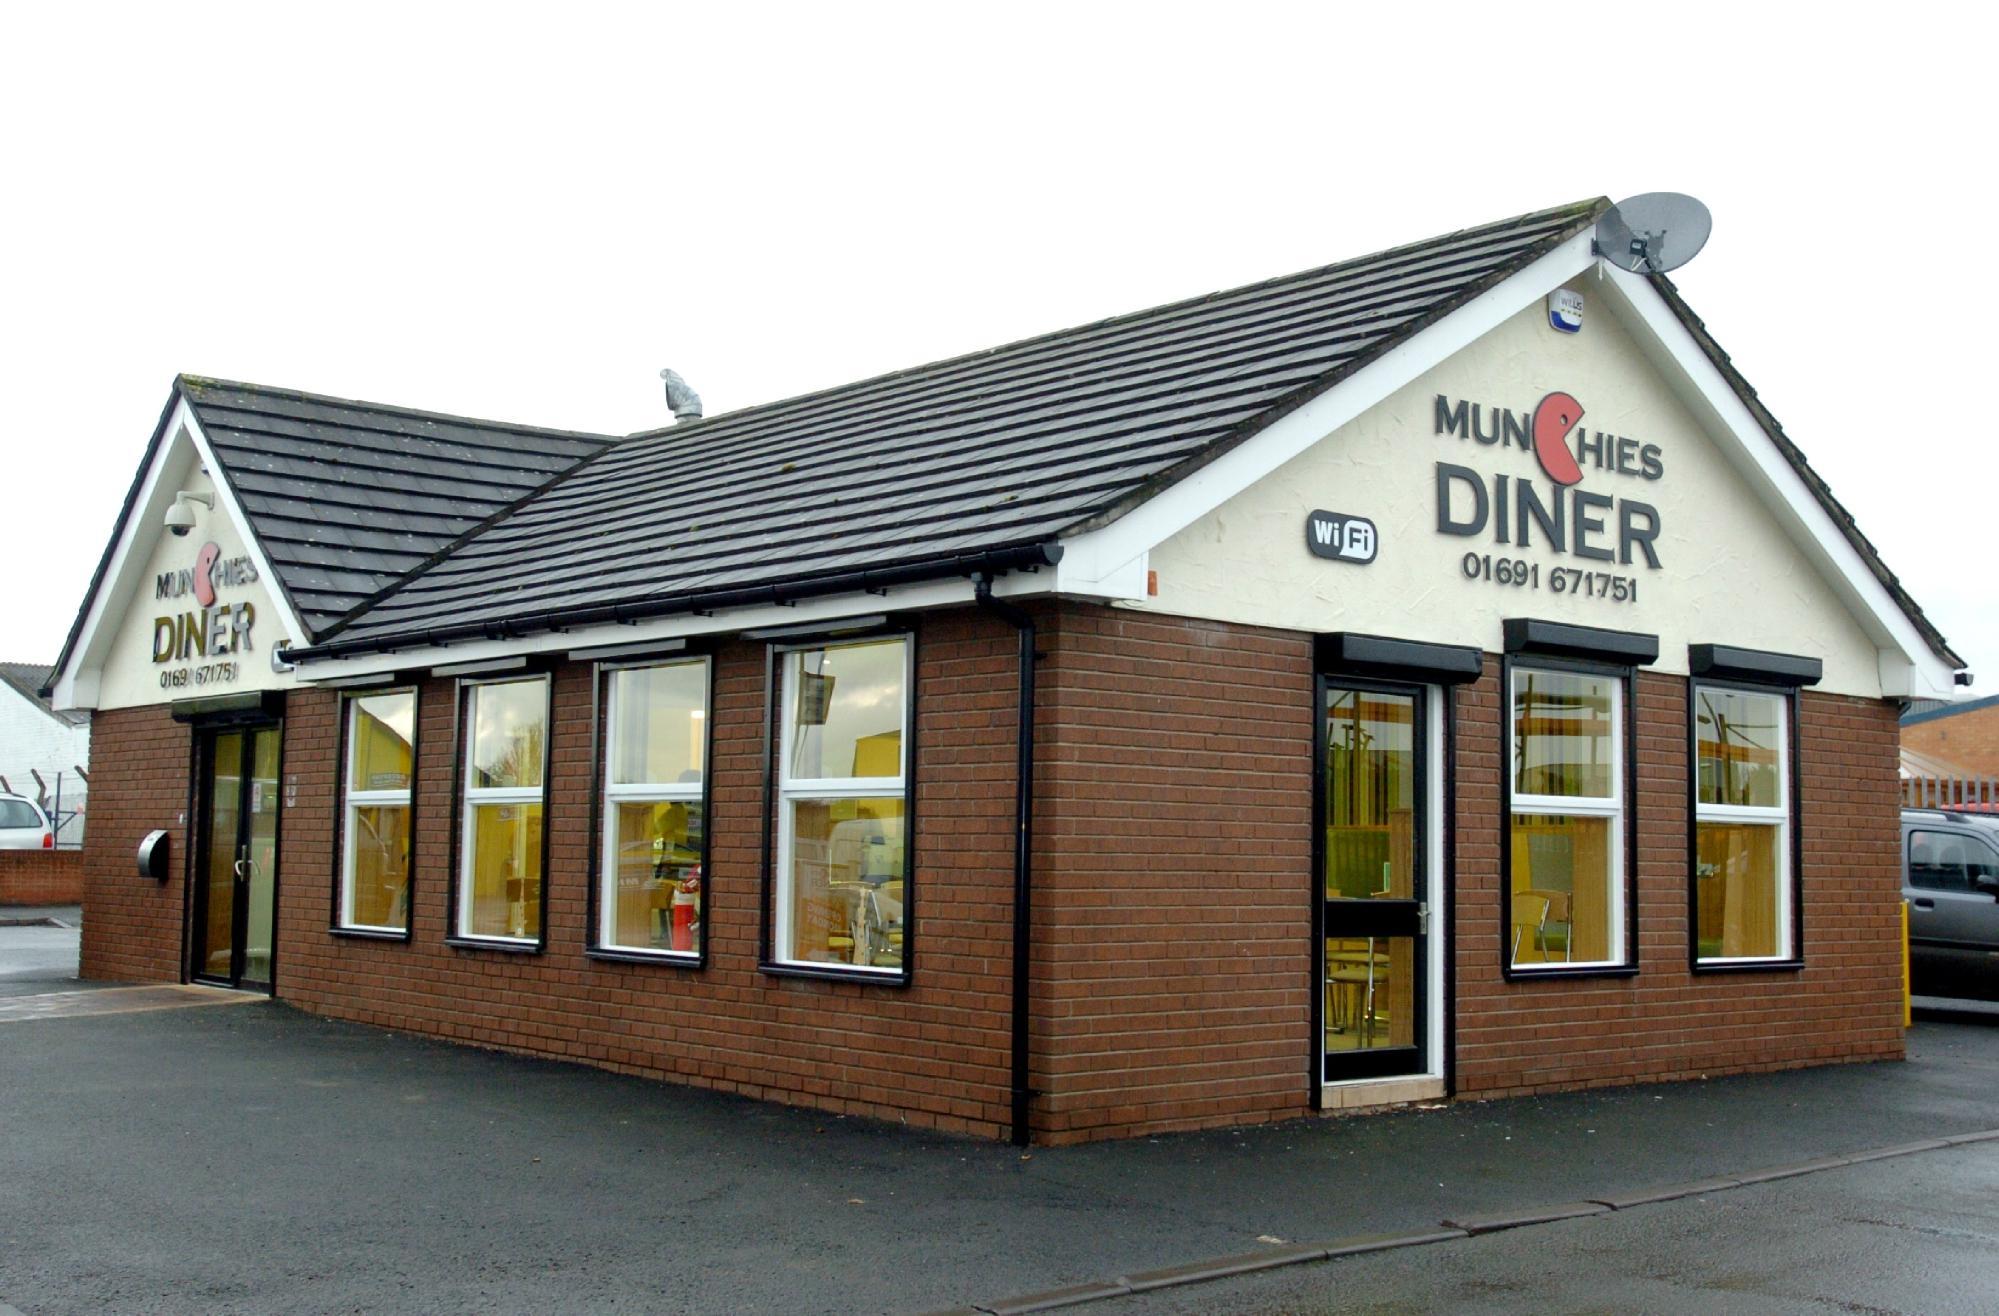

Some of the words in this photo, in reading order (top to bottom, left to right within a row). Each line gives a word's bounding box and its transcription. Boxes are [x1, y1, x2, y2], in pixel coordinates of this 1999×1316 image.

[1436, 461, 1663, 569] DINER
[1463, 552, 1539, 588] 01691
[1550, 566, 1638, 602] 671751
[152, 601, 256, 663] DINER
[160, 668, 195, 688] 01691
[195, 661, 239, 685] 671751
